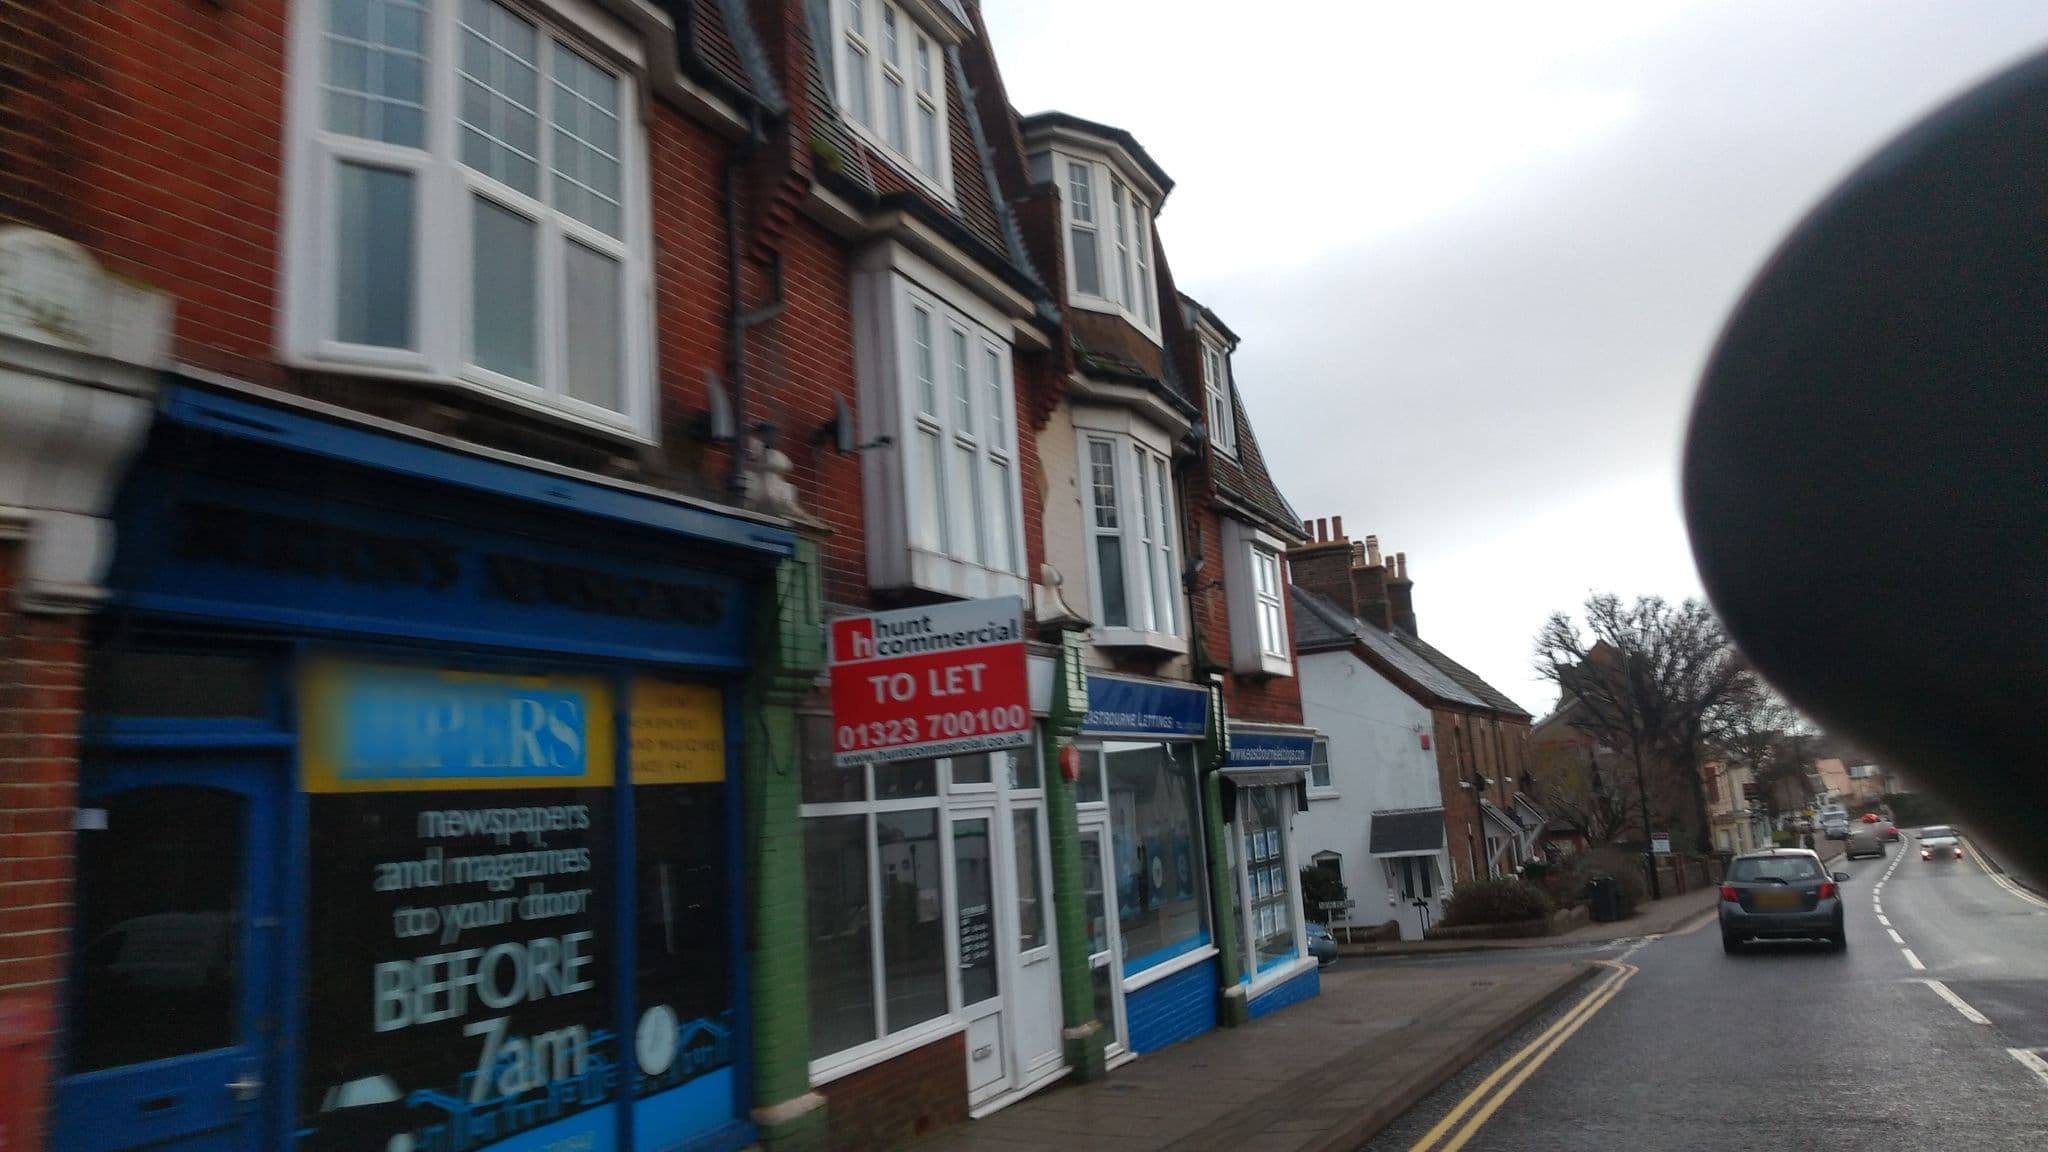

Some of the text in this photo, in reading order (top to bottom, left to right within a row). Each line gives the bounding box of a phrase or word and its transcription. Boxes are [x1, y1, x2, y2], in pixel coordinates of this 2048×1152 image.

[875, 615, 932, 638] hunt
[876, 618, 1021, 656] commercial
[867, 662, 988, 704] TO LET
[838, 704, 1025, 750] 01323 700100
[418, 804, 591, 848] newspapers
[374, 847, 591, 892] and magazines
[393, 882, 592, 945] to your door
[374, 930, 595, 1033] BEFORE
[464, 1016, 590, 1104] 7am
